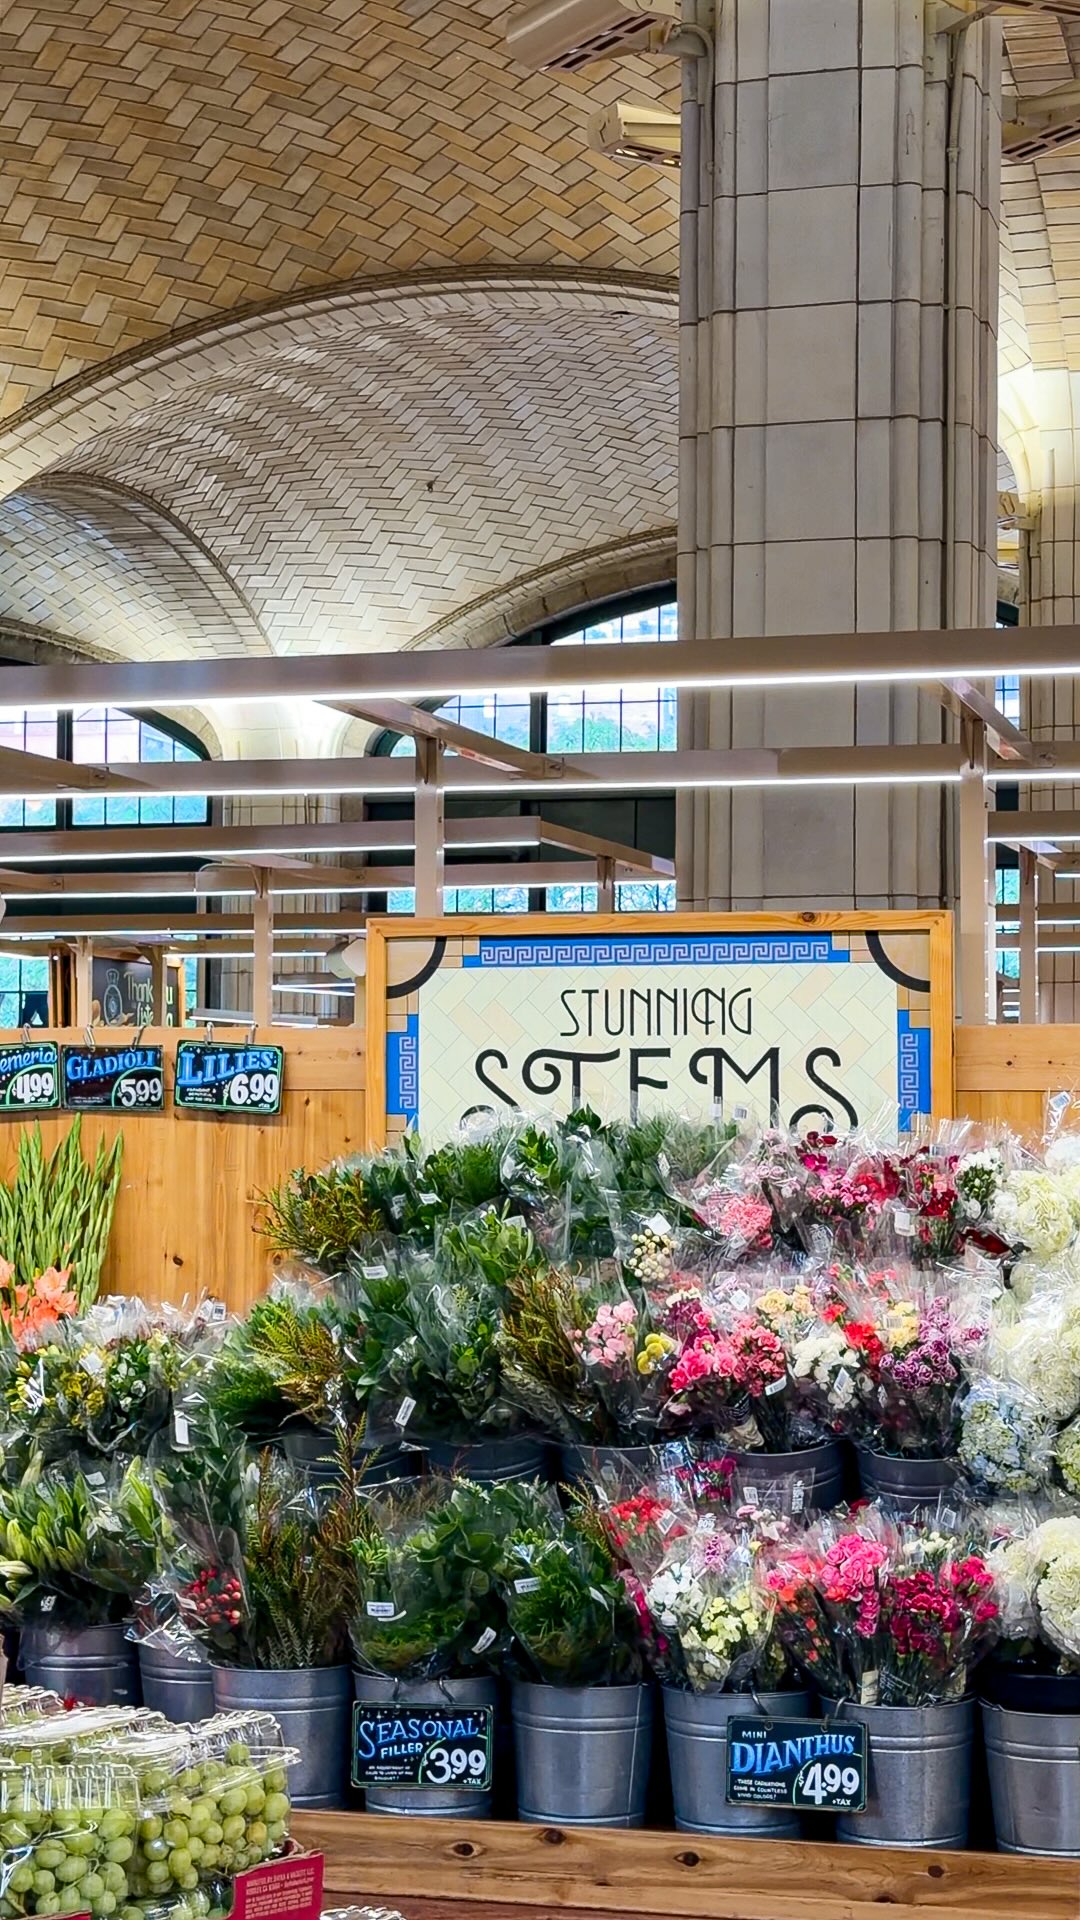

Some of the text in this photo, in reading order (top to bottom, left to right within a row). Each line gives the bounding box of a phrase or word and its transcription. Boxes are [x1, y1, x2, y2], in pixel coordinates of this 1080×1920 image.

[560, 987, 752, 1037] STUNNING
[66, 1050, 156, 1080] GLADIOLI
[177, 1051, 273, 1085] LILIES
[461, 1047, 858, 1131] STEMS
[359, 1718, 479, 1758] SEASONAL
[381, 1743, 423, 1759] FILLER
[742, 1730, 767, 1739] MINI
[731, 1734, 856, 1774] DIANTHUS
